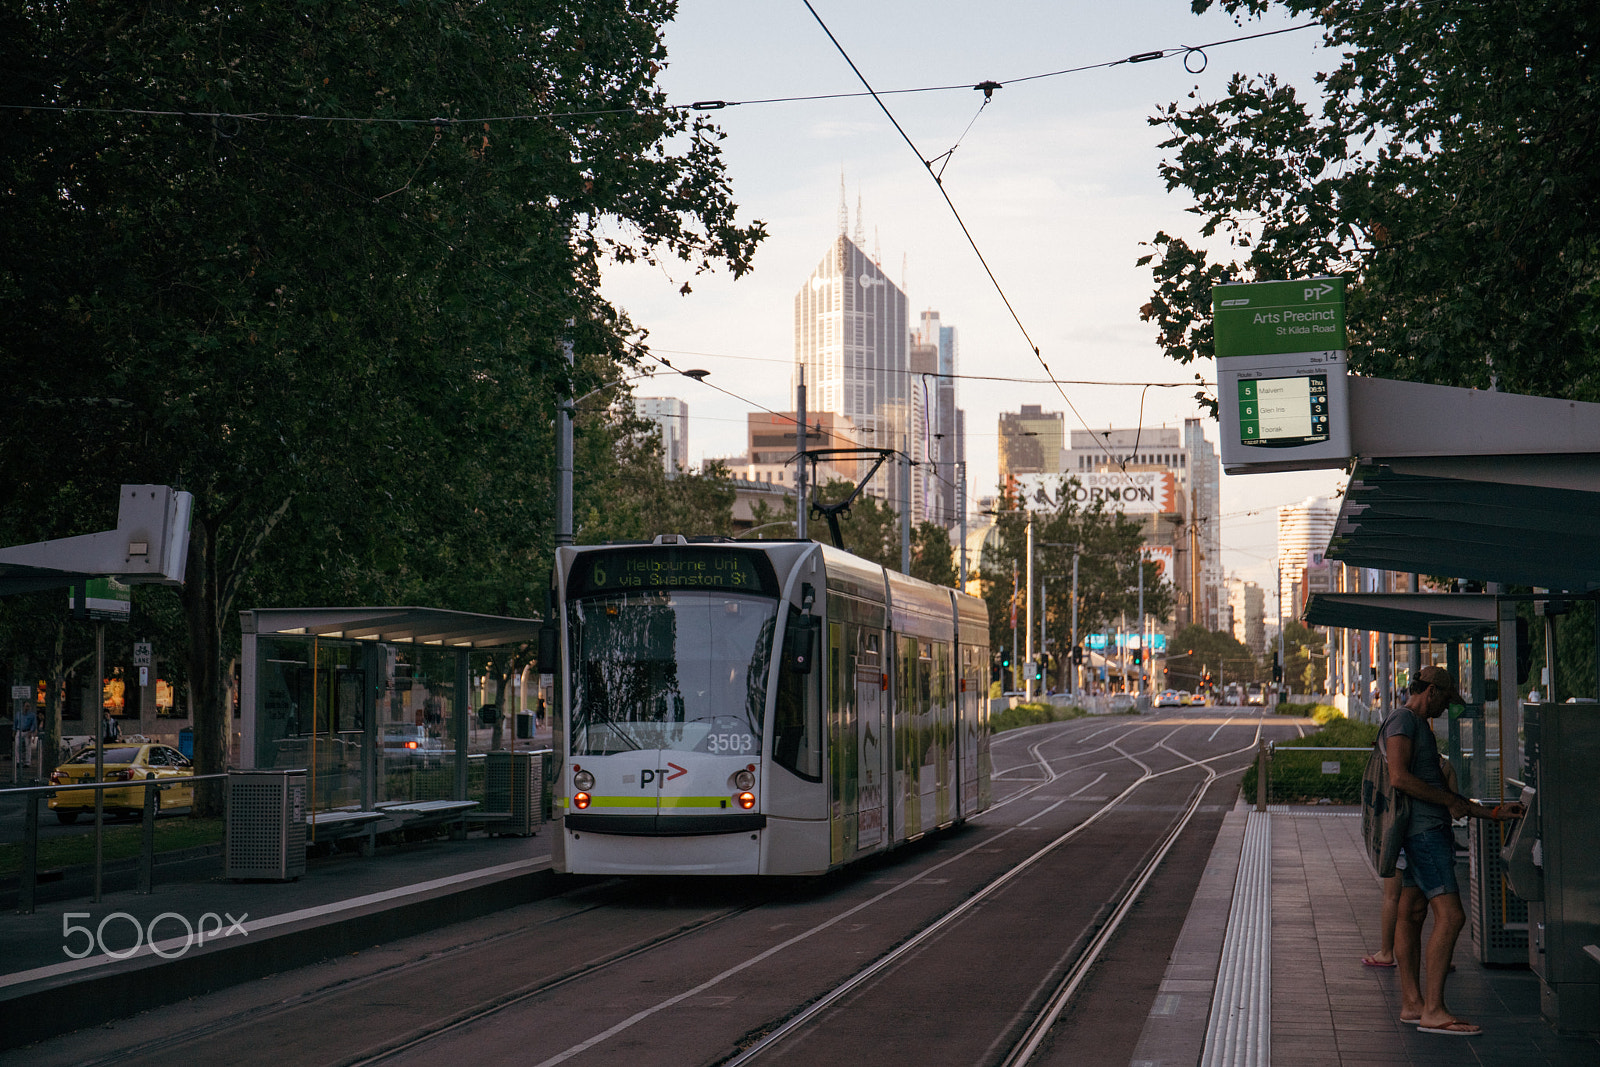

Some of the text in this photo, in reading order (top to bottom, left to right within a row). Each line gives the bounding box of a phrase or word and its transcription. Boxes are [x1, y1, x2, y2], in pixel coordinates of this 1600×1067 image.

[1253, 309, 1335, 324] Arts Precinct
[1276, 324, 1336, 335] St Kilda Road
[1323, 350, 1338, 361] 14
[1245, 387, 1251, 395] 5
[1246, 407, 1252, 415] 6
[1247, 426, 1253, 434] 8
[1316, 424, 1323, 432] 5
[1088, 474, 1129, 485] BOOK
[1135, 473, 1155, 485] OF
[626, 557, 738, 571] Melbourne Uni
[593, 561, 607, 586] 6
[619, 572, 748, 586] via Swanston St
[707, 733, 752, 751] 3503
